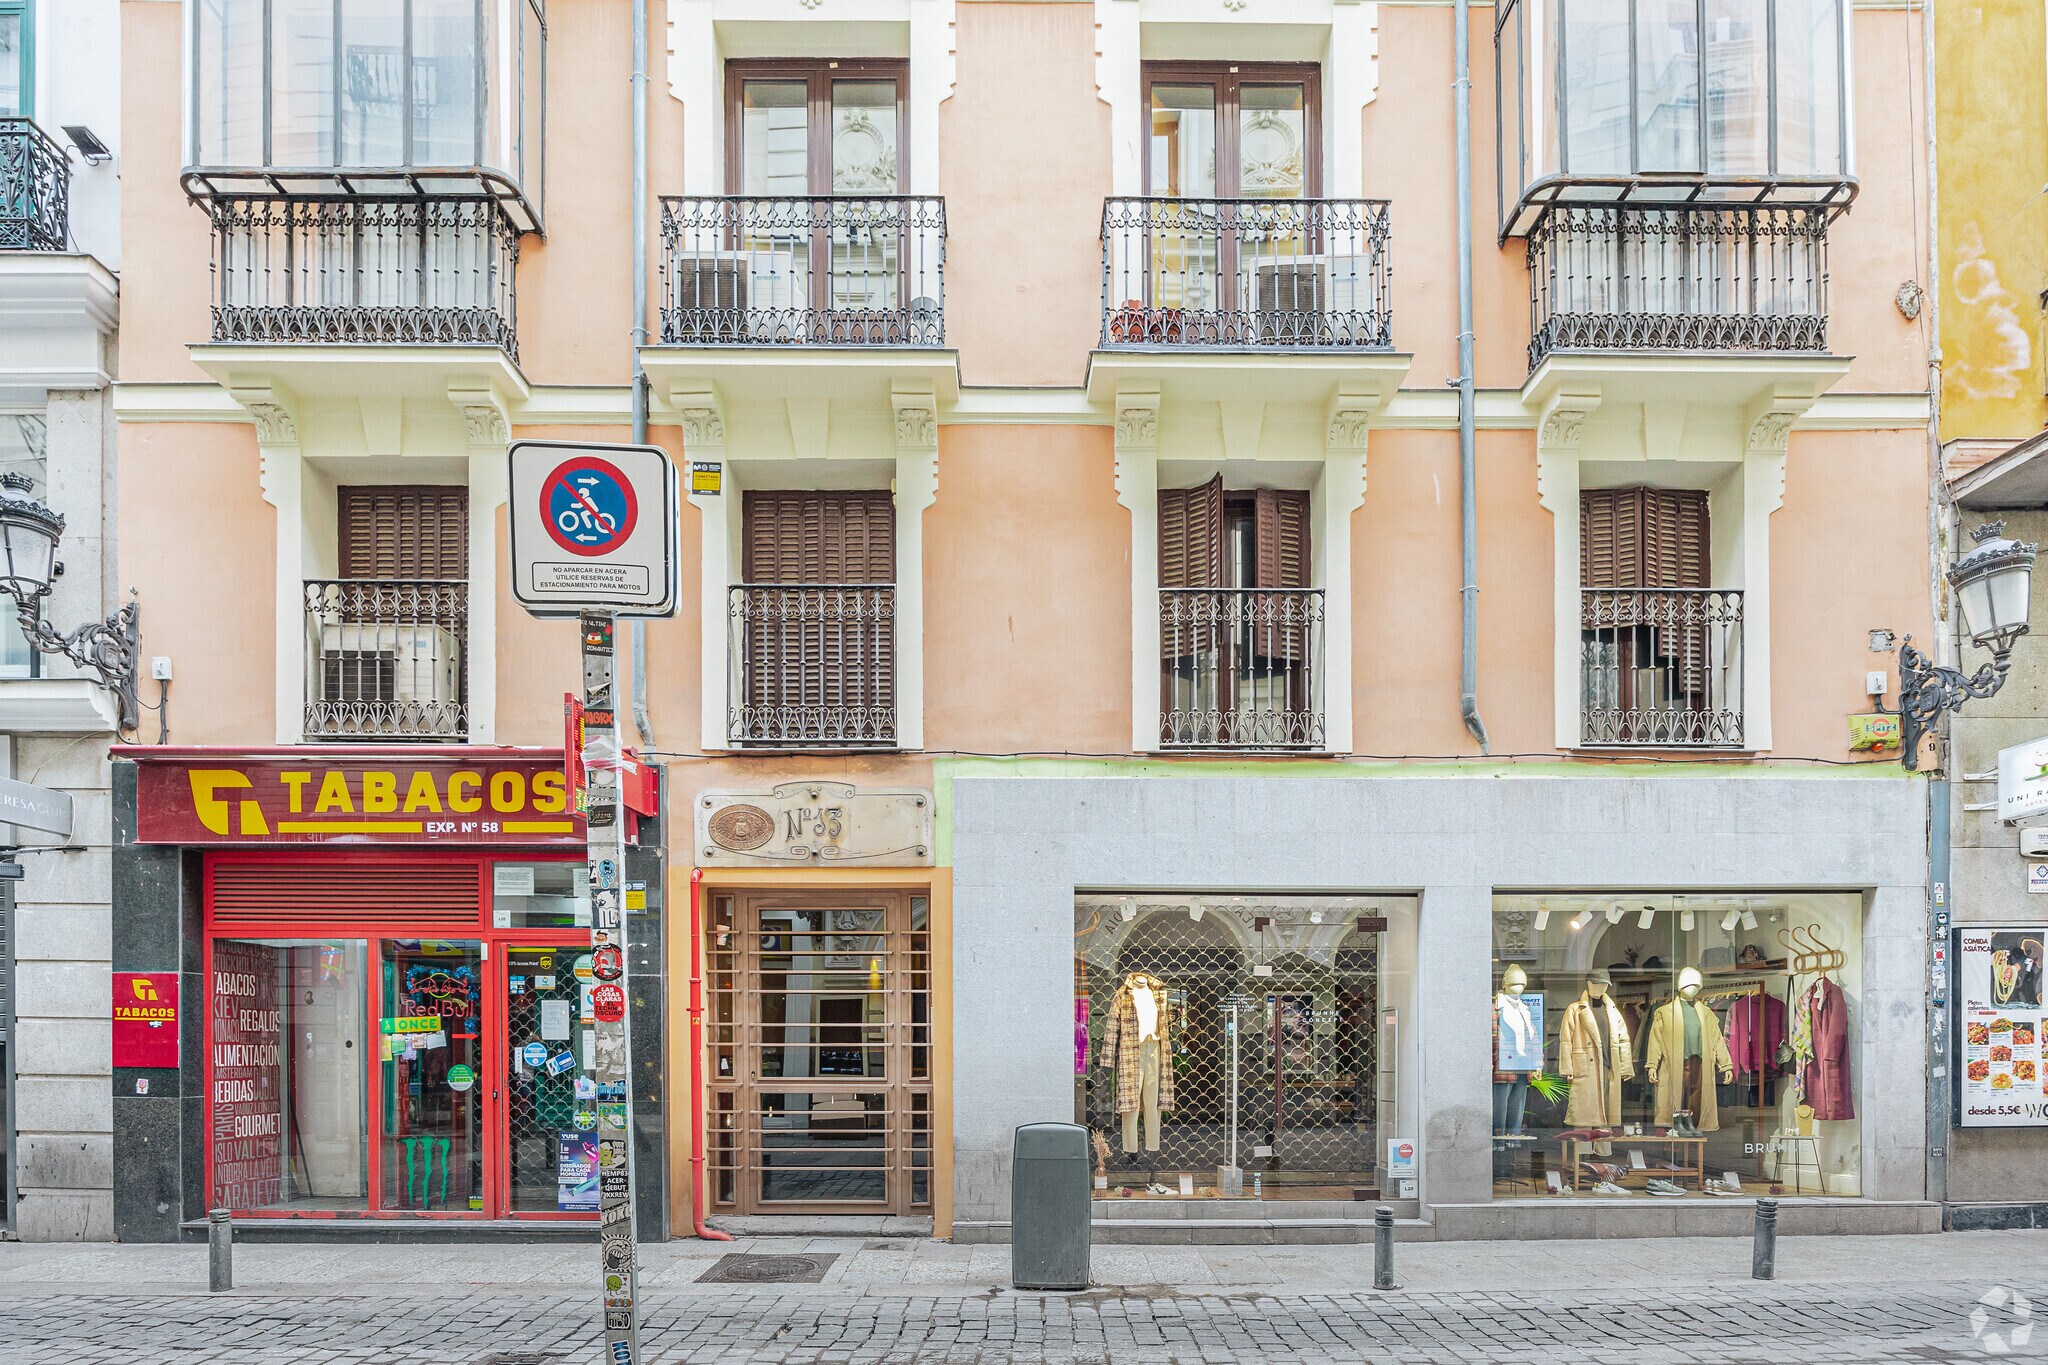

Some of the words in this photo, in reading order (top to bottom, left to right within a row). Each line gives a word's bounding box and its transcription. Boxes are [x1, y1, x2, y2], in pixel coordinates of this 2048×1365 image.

[280, 771, 566, 813] TABACOS
[2008, 794, 2029, 804] UNI
[427, 822, 457, 833] EXP.
[481, 822, 498, 833] 58
[115, 1007, 175, 1017] TABACOS
[406, 1000, 439, 1016] Red
[442, 1000, 474, 1017] Bull
[241, 1009, 280, 1032] REGALOS
[398, 1018, 437, 1030] ONCE
[1968, 1106, 1996, 1115] desde
[1998, 1106, 2021, 1116] 5,5€
[235, 1114, 280, 1138] GOURMET
